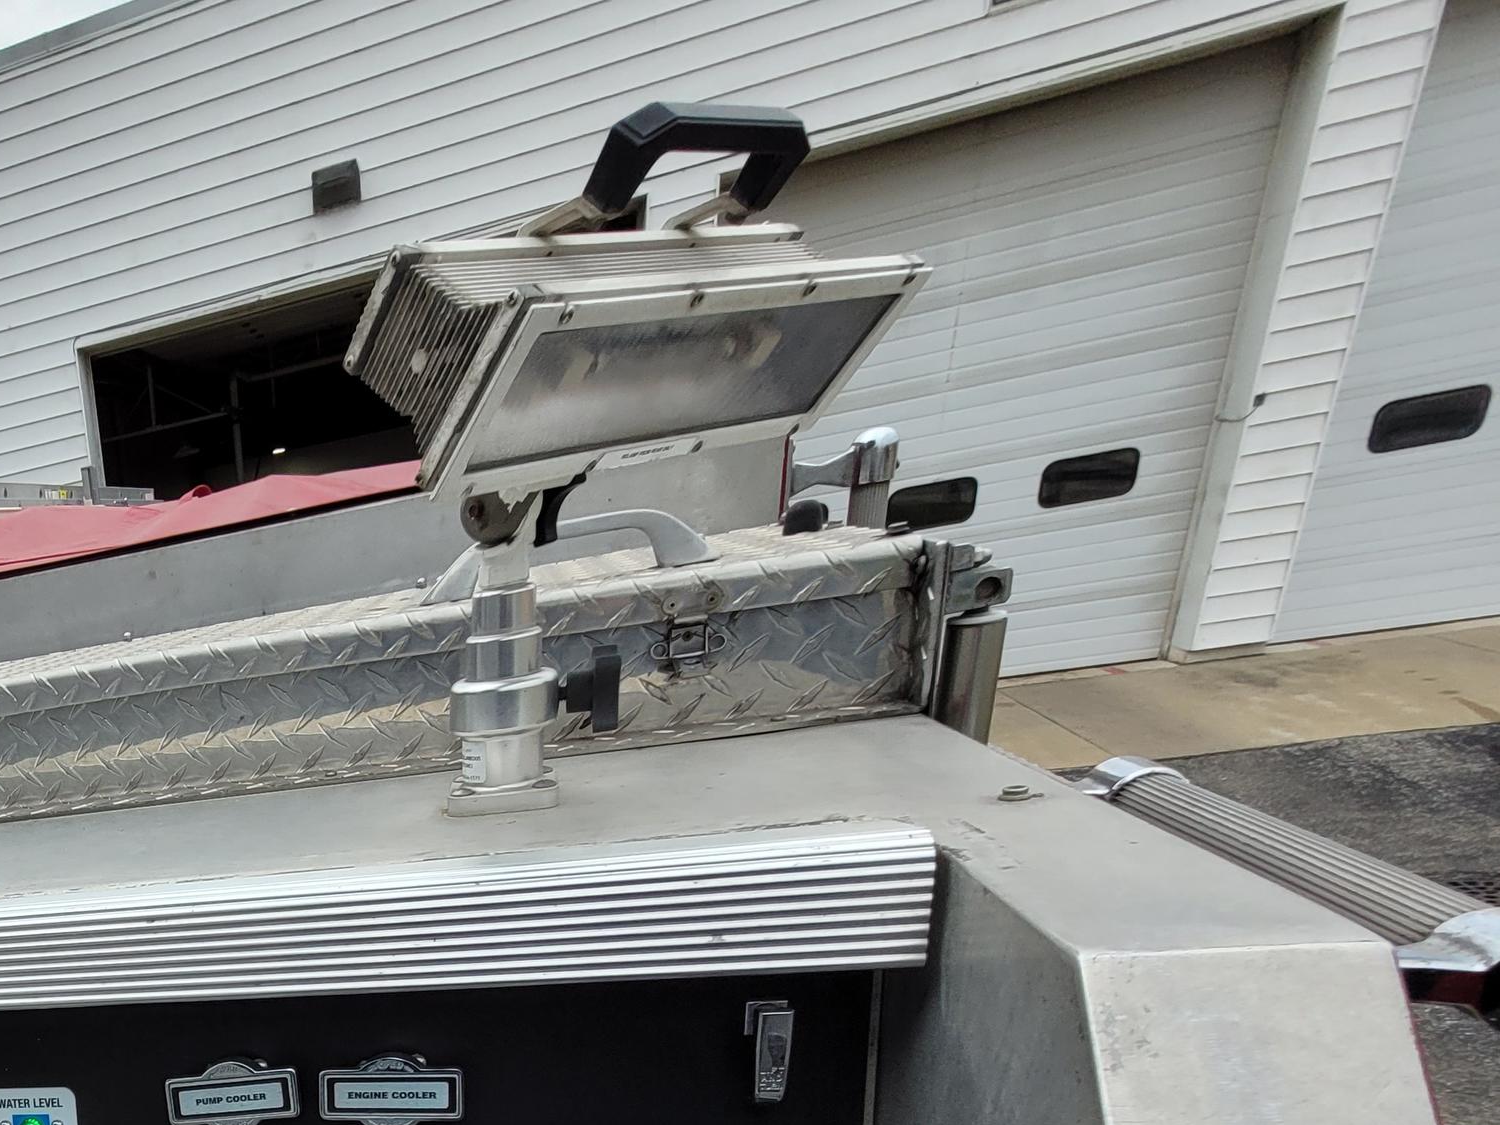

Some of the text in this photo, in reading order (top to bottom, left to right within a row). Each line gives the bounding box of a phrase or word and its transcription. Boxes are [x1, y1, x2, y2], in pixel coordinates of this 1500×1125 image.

[196, 1093, 266, 1106] PUMP COOLER
[392, 1092, 436, 1100] COOLER
[34, 1098, 63, 1108] LEVEL
